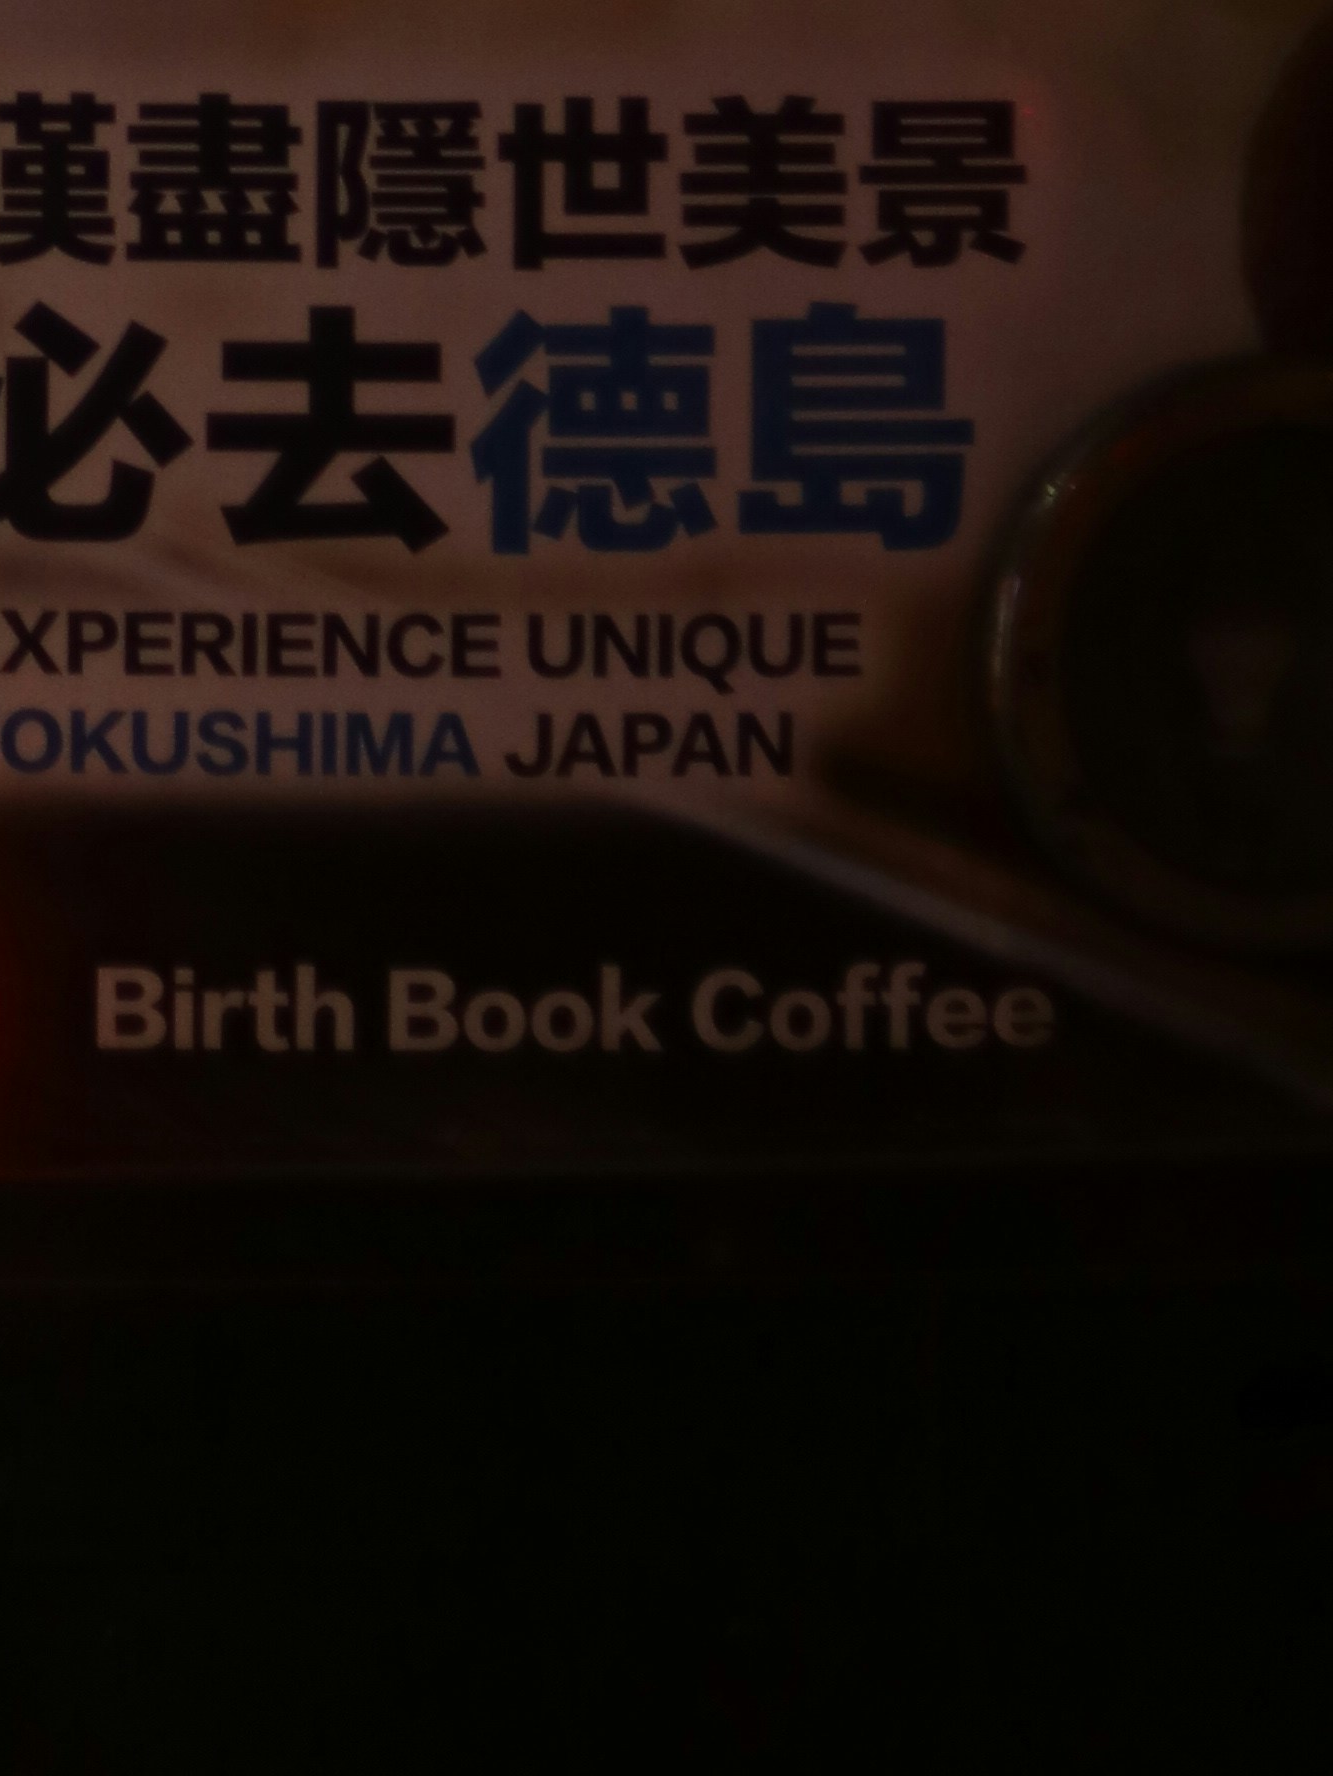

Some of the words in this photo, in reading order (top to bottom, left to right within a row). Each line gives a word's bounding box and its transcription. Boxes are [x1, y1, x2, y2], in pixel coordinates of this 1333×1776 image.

[523, 611, 864, 697] UNIQUE
[503, 710, 796, 778] JAPAN
[92, 959, 357, 1055] Birth
[385, 959, 661, 1055] Book
[687, 960, 1057, 1055] Coffee
